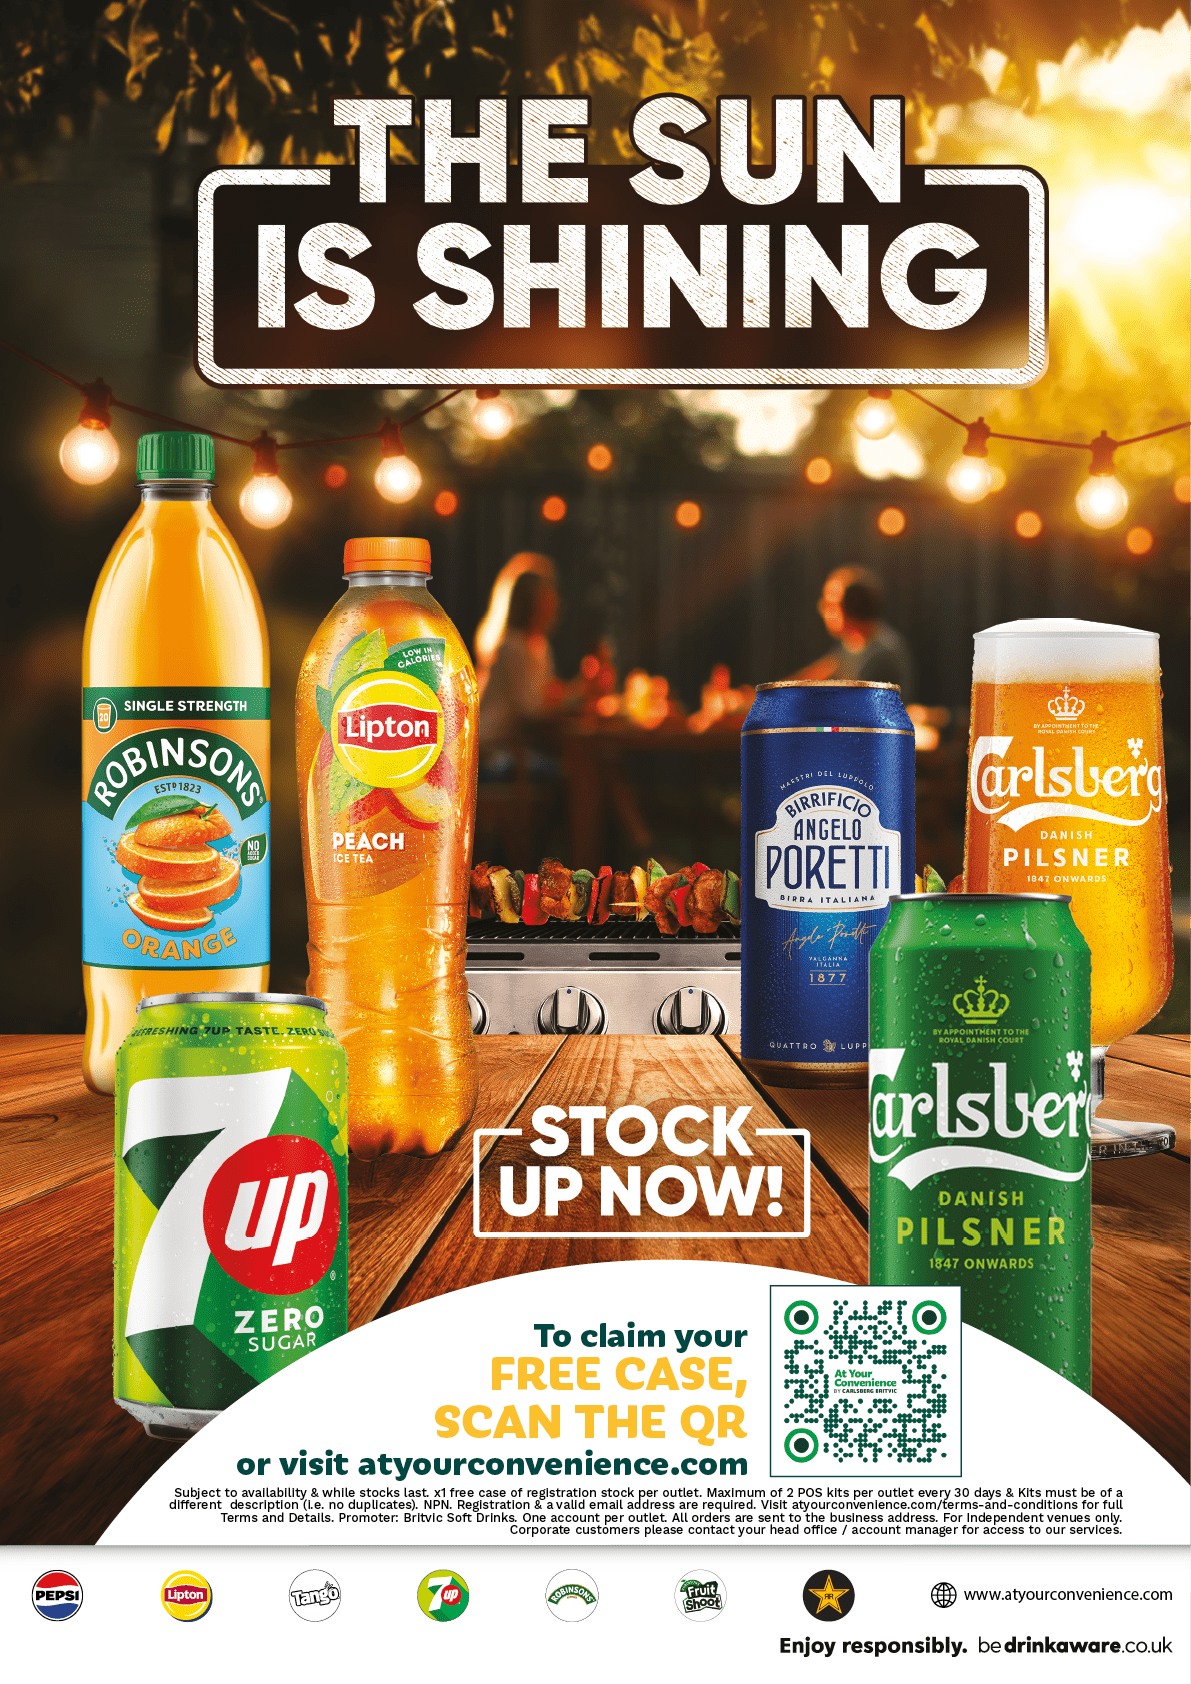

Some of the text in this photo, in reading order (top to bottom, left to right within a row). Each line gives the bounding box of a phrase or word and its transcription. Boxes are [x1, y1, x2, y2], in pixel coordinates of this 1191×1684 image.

[334, 96, 901, 205] THE SUN
[257, 223, 988, 330] IS SHINING
[397, 654, 440, 668] CALORIES
[402, 648, 421, 658] LOW
[124, 700, 247, 712] SINGLE STRENGTH
[99, 713, 109, 722] 20
[346, 715, 430, 743] Lipton
[94, 737, 260, 807] ROBINSONS
[971, 735, 1162, 815] Carlsberg
[179, 782, 202, 794] 1823
[780, 772, 814, 790] MAESTRI
[838, 771, 874, 791] LUPPOLO
[785, 792, 872, 818] BIRRIFICIO
[794, 818, 862, 841] ANGELO
[1040, 831, 1093, 840] DANISH
[247, 840, 260, 850] NO
[332, 832, 405, 851] PEACH
[333, 853, 374, 863] ICE TEA
[1003, 848, 1129, 867] PILSNER
[766, 844, 890, 890] PORETTI
[1027, 875, 1107, 883] 1847 ONWARDS
[780, 894, 875, 904] BIRRA ITALIANA
[122, 926, 237, 960] ORANGE
[809, 973, 847, 983] 1877
[204, 1026, 230, 1036] 7UP
[286, 1027, 316, 1036] ZERO
[932, 1028, 1029, 1036] BY APPOINTMENT TO THE
[769, 1042, 817, 1050] QUATTRO
[939, 1036, 1024, 1044] ROYAL DANISH COURT
[530, 1105, 754, 1157] STOCK
[501, 1165, 783, 1217] UP NOW!
[939, 1191, 1024, 1206] DANISH
[122, 1067, 329, 1337] 7up
[897, 1217, 1065, 1246] PILSNER
[929, 1257, 1034, 1270] 1847 ONWARDS
[234, 1305, 324, 1334] ZERO
[248, 1332, 317, 1352] SUGAR
[534, 1321, 748, 1354] To claim your
[491, 1357, 748, 1396] FREE CASE,
[834, 1369, 873, 1378] At Your
[834, 1377, 897, 1387] Convenience
[435, 1404, 748, 1447] SCAN THE QR
[237, 1450, 748, 1482] or visit atyourconvenience.com
[175, 1487, 221, 1500] Subject
[225, 1488, 237, 1497] to
[242, 1487, 307, 1500] availability
[322, 1487, 355, 1497] while
[360, 1487, 400, 1497] stocks
[404, 1487, 429, 1497] last.
[450, 1487, 474, 1497] free
[511, 1487, 523, 1497] of
[527, 1487, 596, 1500] registration
[601, 1487, 634, 1497] stock
[639, 1490, 658, 1500] per
[663, 1487, 702, 1497] outlet.
[707, 1487, 765, 1497] Maximum
[770, 1487, 783, 1497] of
[798, 1488, 822, 1497] POS
[827, 1487, 849, 1497] kits
[854, 1490, 873, 1500] per
[878, 1487, 914, 1497] outlet
[918, 1490, 951, 1500] every
[954, 1488, 969, 1497] 30
[974, 1487, 1001, 1500] days
[1019, 1487, 1041, 1497] Kits
[1046, 1488, 1077, 1497] must
[1081, 1487, 1095, 1497] be
[1100, 1487, 1112, 1497] of
[169, 1499, 222, 1509] different
[230, 1499, 298, 1512] description
[424, 1500, 452, 1509] NPN.
[458, 1499, 530, 1512] Registration
[557, 1499, 585, 1509] valid
[589, 1499, 623, 1509] email
[627, 1499, 675, 1509] address
[703, 1499, 756, 1512] required.
[761, 1499, 787, 1509] Visit
[792, 1499, 1078, 1512] atyourconvenience.com/terms-and-conditions
[1082, 1499, 1099, 1509] for
[1103, 1499, 1123, 1509] full
[510, 1526, 570, 1537] Corporate
[576, 1526, 640, 1534] customers
[645, 1525, 683, 1537] please
[688, 1526, 735, 1534] contact
[738, 1528, 766, 1537] your
[770, 1525, 799, 1534] head
[804, 1525, 837, 1534] office
[852, 1526, 901, 1534] account
[906, 1528, 958, 1537] manager
[962, 1525, 979, 1534] for
[1029, 1526, 1041, 1534] to
[1070, 1525, 1122, 1534] services.
[36, 1590, 79, 1601] PEPSI
[167, 1589, 204, 1602] Lipton
[291, 1585, 340, 1606] Tango
[427, 1576, 459, 1612] 7up
[550, 1586, 594, 1602] ROBINSONS
[687, 1584, 716, 1598] Fruit
[963, 1588, 1173, 1604] www.atyourconvenience.com
[685, 1597, 720, 1611] Shoot
[780, 1636, 836, 1658] Enjoy
[843, 1636, 968, 1658] responsibly.
